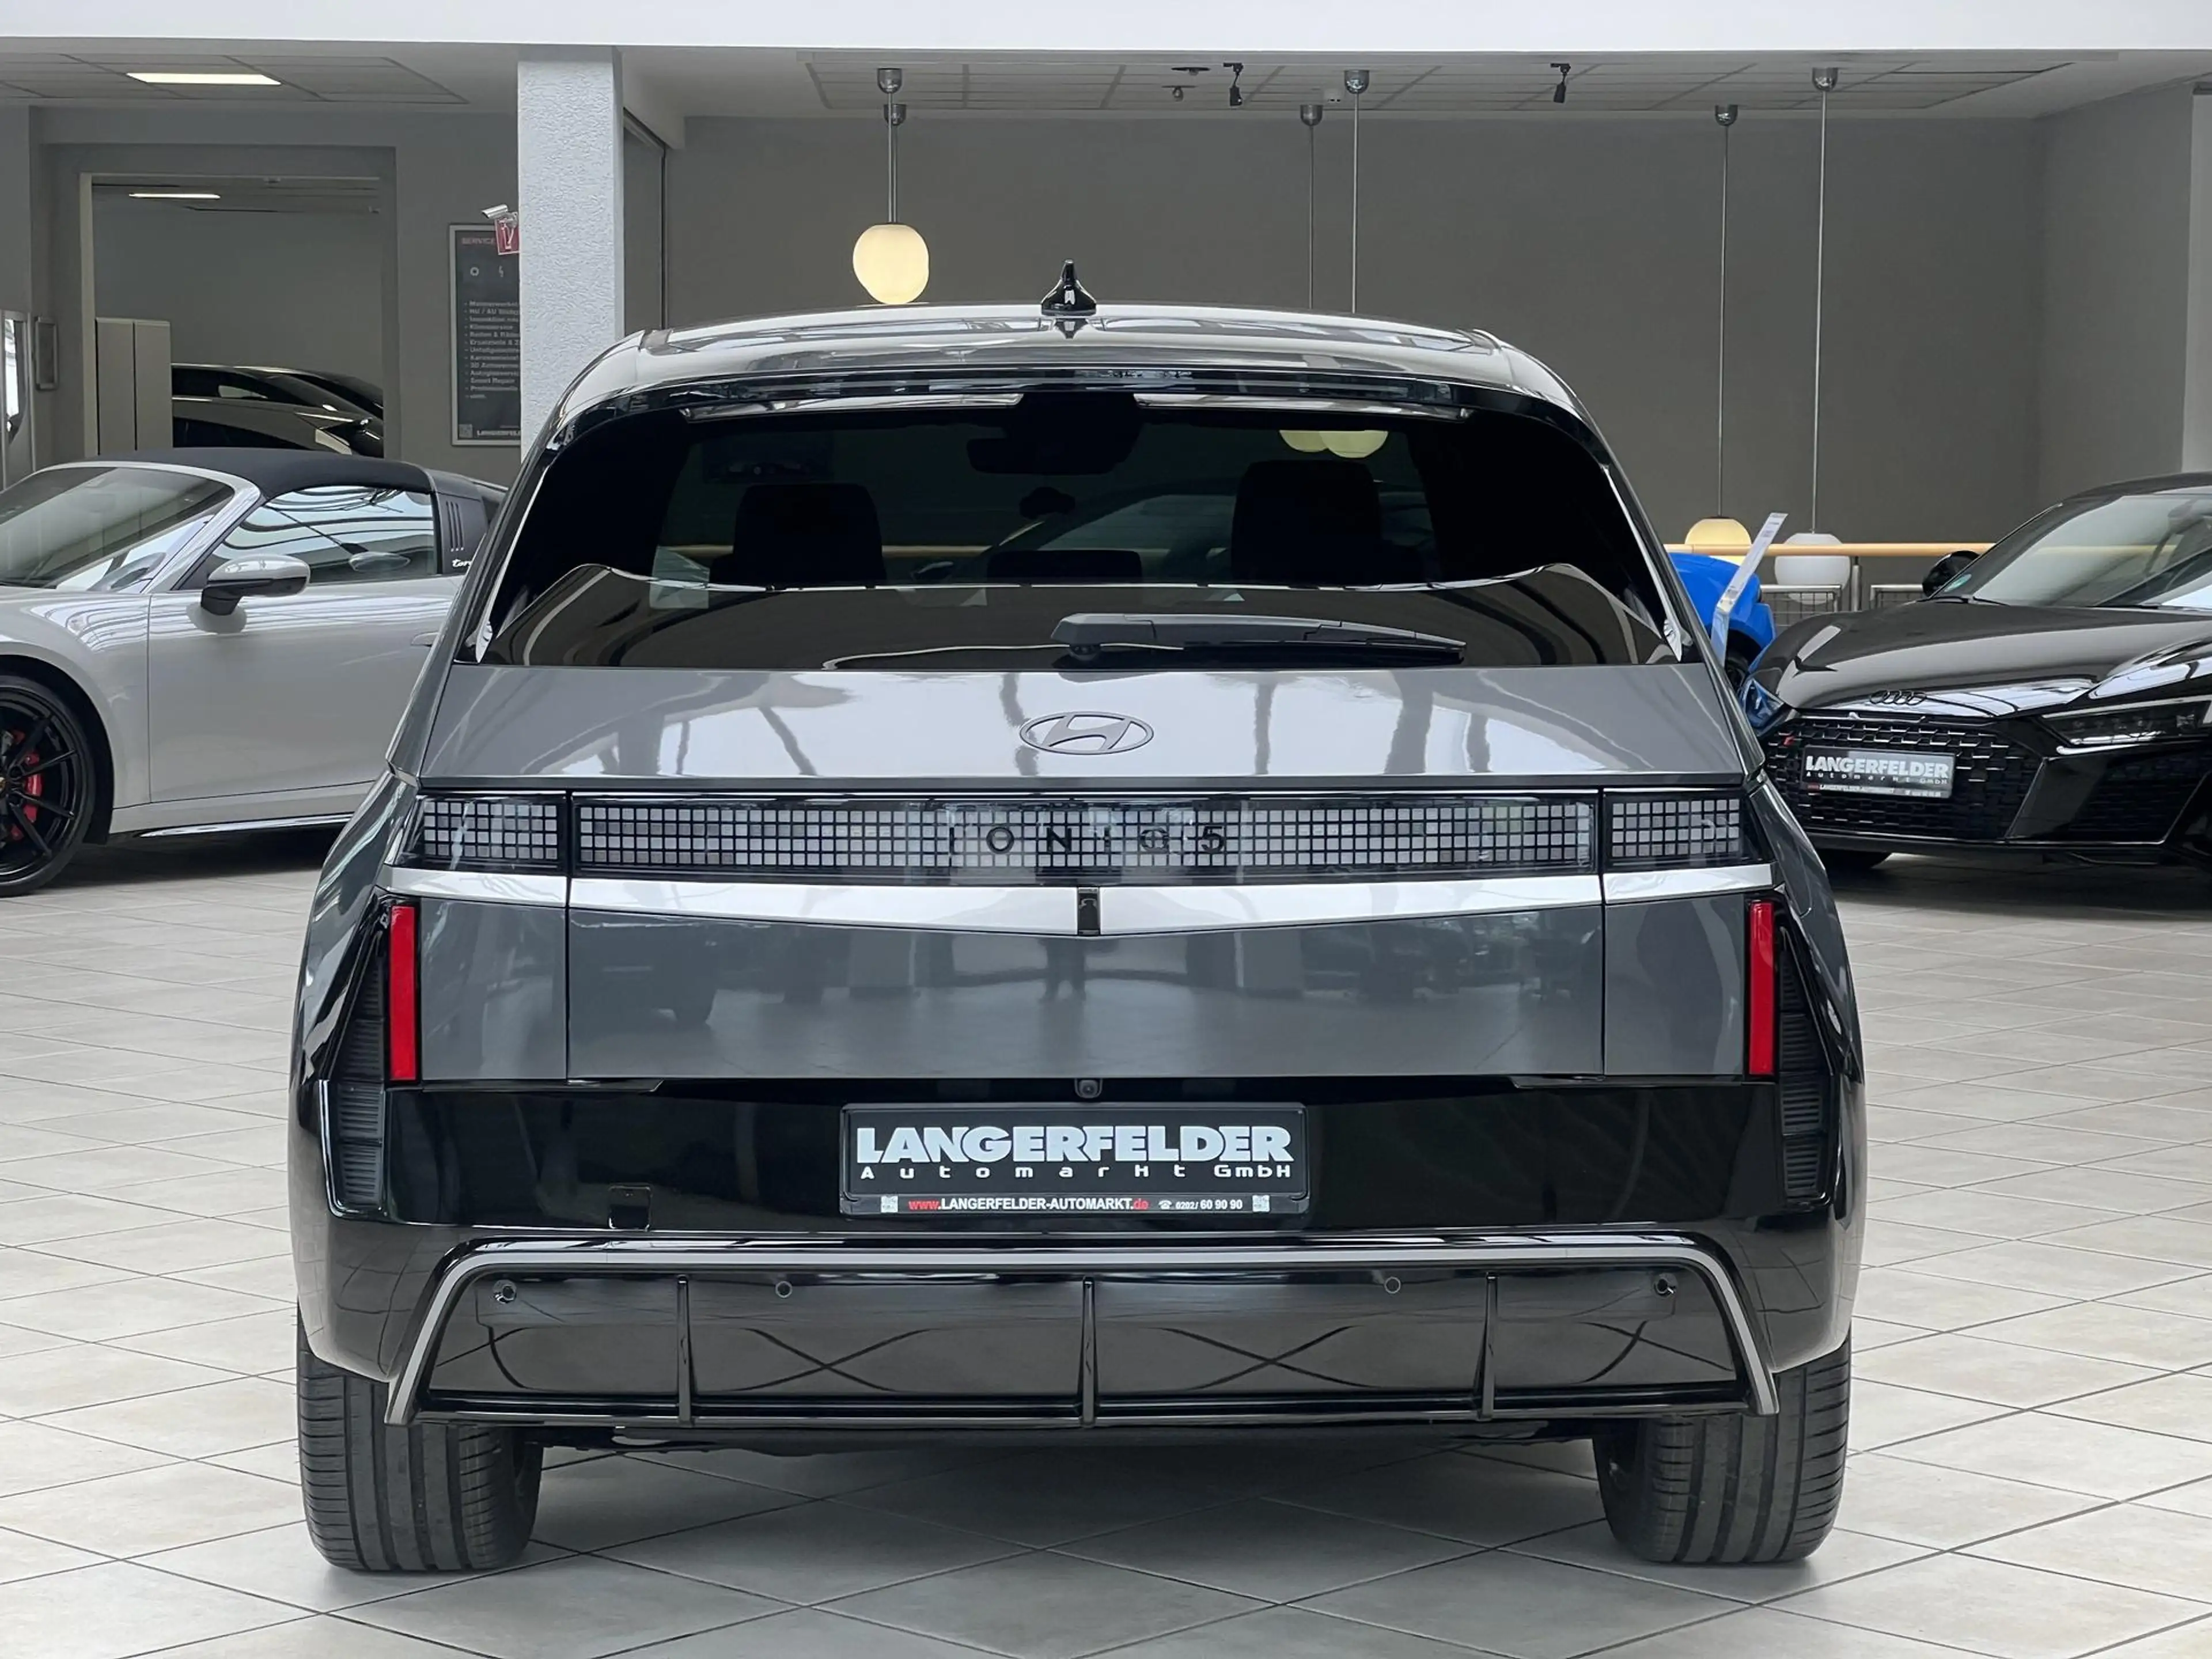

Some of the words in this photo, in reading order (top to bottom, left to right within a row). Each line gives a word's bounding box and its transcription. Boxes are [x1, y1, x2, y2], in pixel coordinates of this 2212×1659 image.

[1805, 755, 1949, 778] LANGERFELDER
[857, 1126, 1294, 1163] LANGERFELDER
[1214, 1164, 1290, 1178] GmbH
[908, 1198, 1150, 1210] www.LANGERFELDER-AUTOMARKT.de
